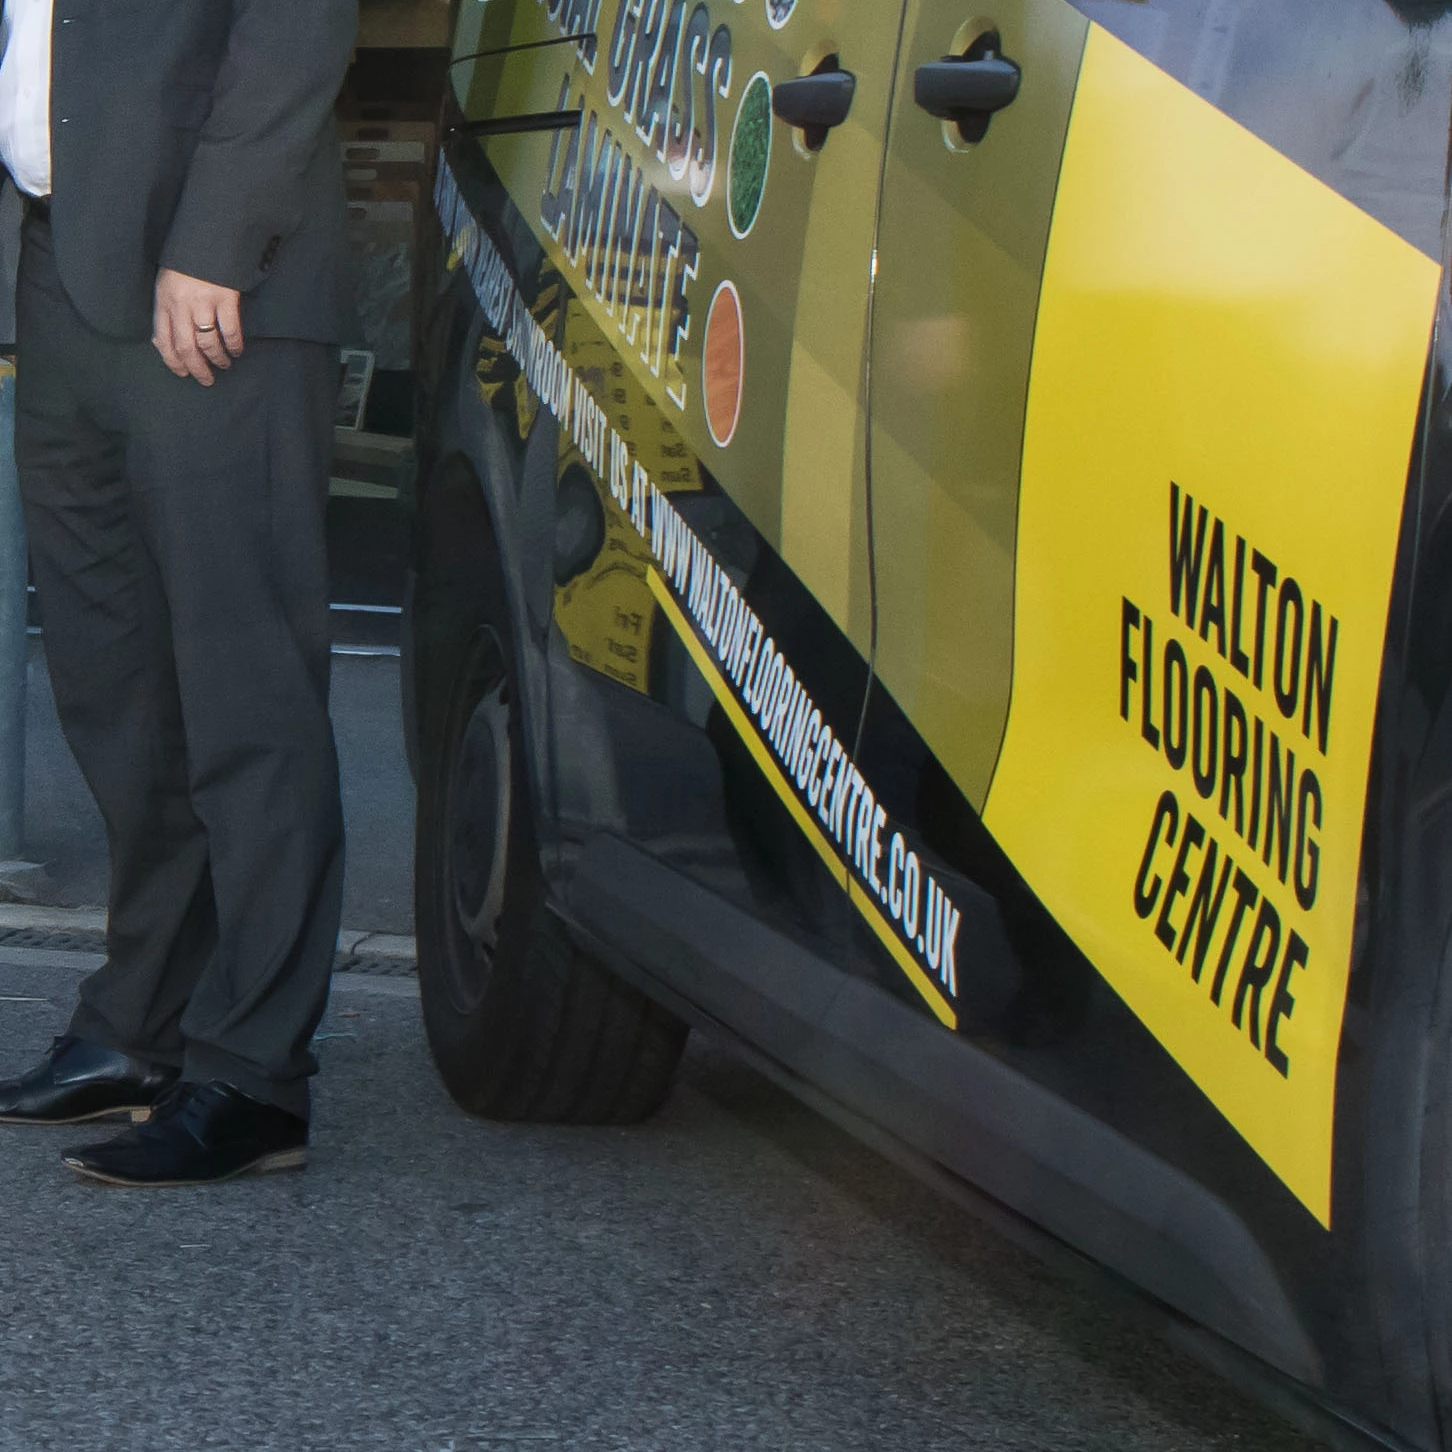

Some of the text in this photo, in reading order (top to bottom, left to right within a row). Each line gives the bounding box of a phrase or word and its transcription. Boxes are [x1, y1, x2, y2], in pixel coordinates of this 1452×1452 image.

[573, 377, 607, 478] VISIT
[610, 428, 628, 510] US
[631, 460, 647, 537] AT
[1119, 596, 1324, 913] FLOORING
[1168, 481, 1339, 757] WALTON
[1132, 789, 1309, 1080] CENTRE
